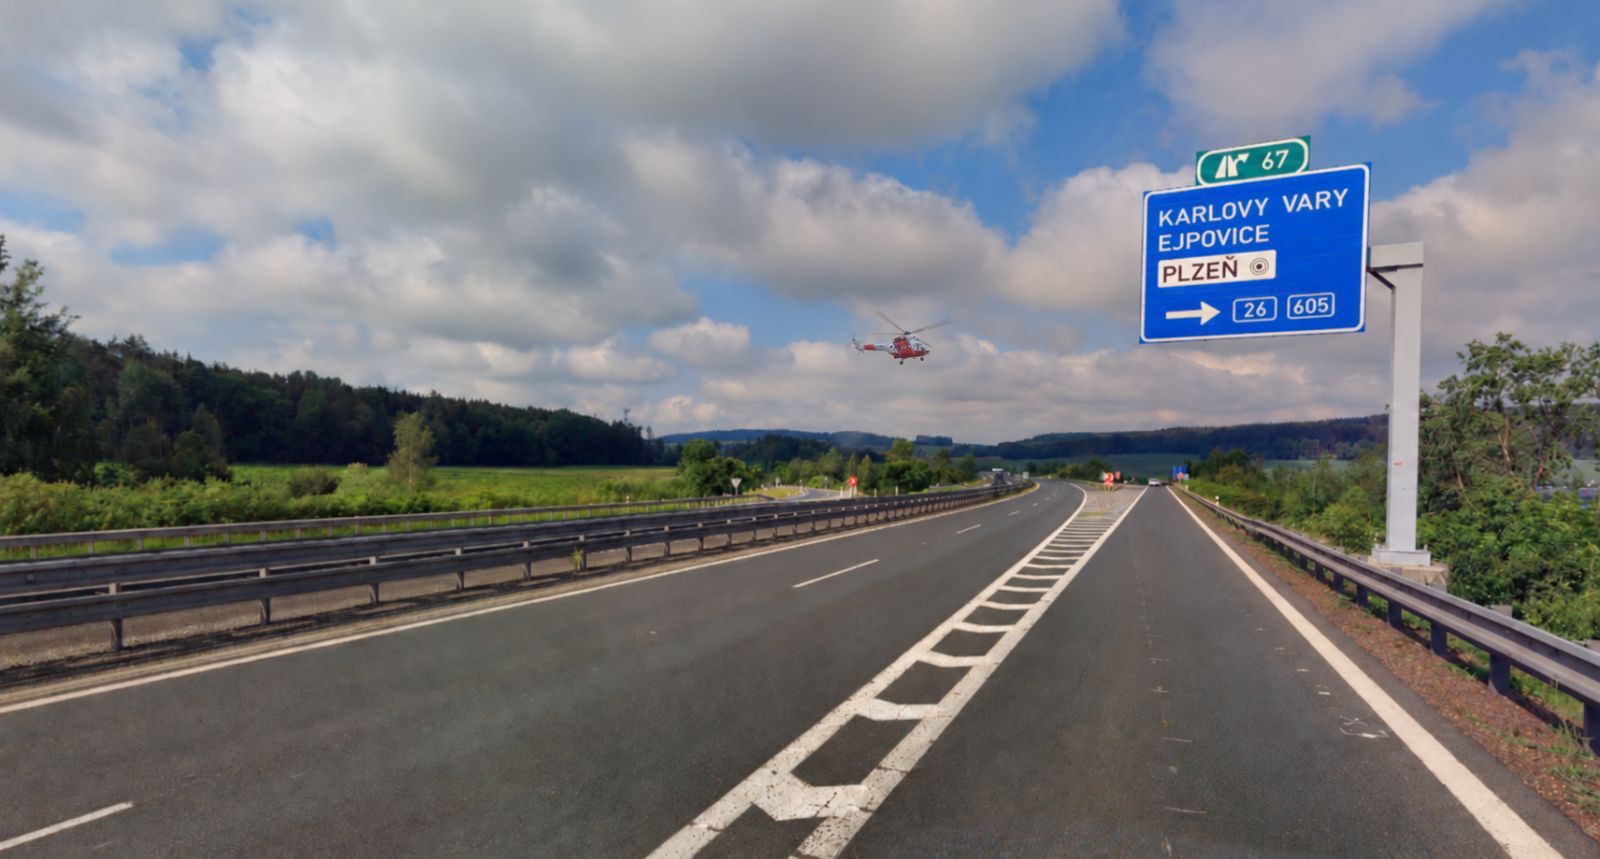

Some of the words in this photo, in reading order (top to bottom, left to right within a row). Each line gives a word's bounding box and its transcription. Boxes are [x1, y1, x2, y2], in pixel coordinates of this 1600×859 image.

[1262, 149, 1289, 170] 67
[1158, 198, 1269, 228] KARLOVY
[1282, 188, 1349, 213] VARY
[1158, 224, 1270, 252] EJPOVICE
[1162, 256, 1238, 283] PLZEŇ
[1244, 302, 1267, 318] 26
[1293, 297, 1329, 315] 605
